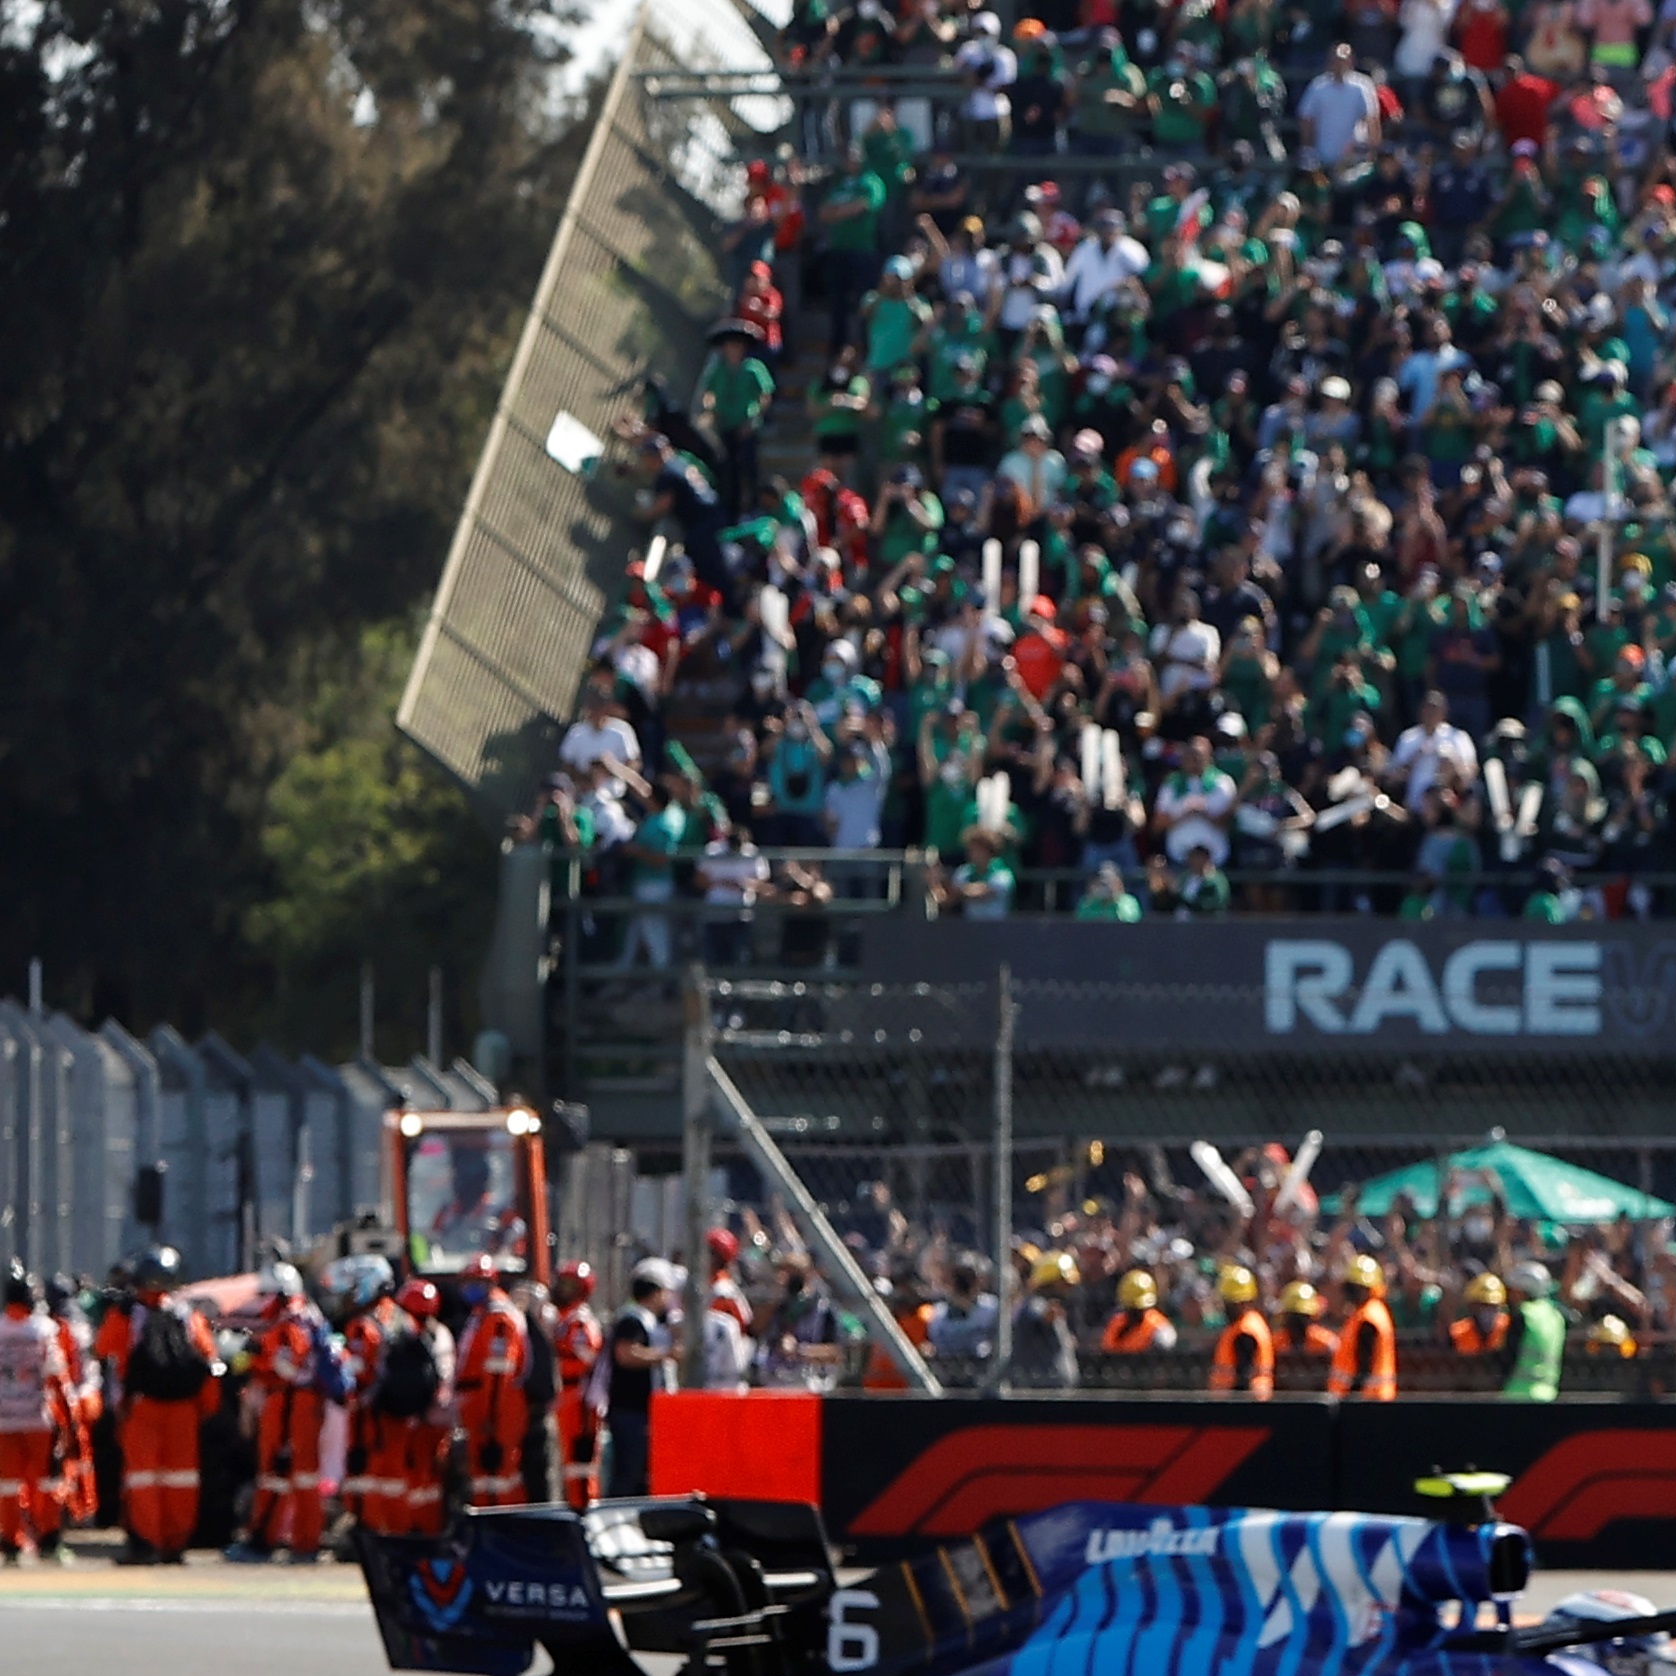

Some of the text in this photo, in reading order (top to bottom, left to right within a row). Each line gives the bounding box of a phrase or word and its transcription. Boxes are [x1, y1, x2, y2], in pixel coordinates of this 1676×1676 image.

[1264, 938, 1600, 1035] RACE
[484, 1579, 589, 1608] VERSA
[827, 1588, 879, 1672] 6
